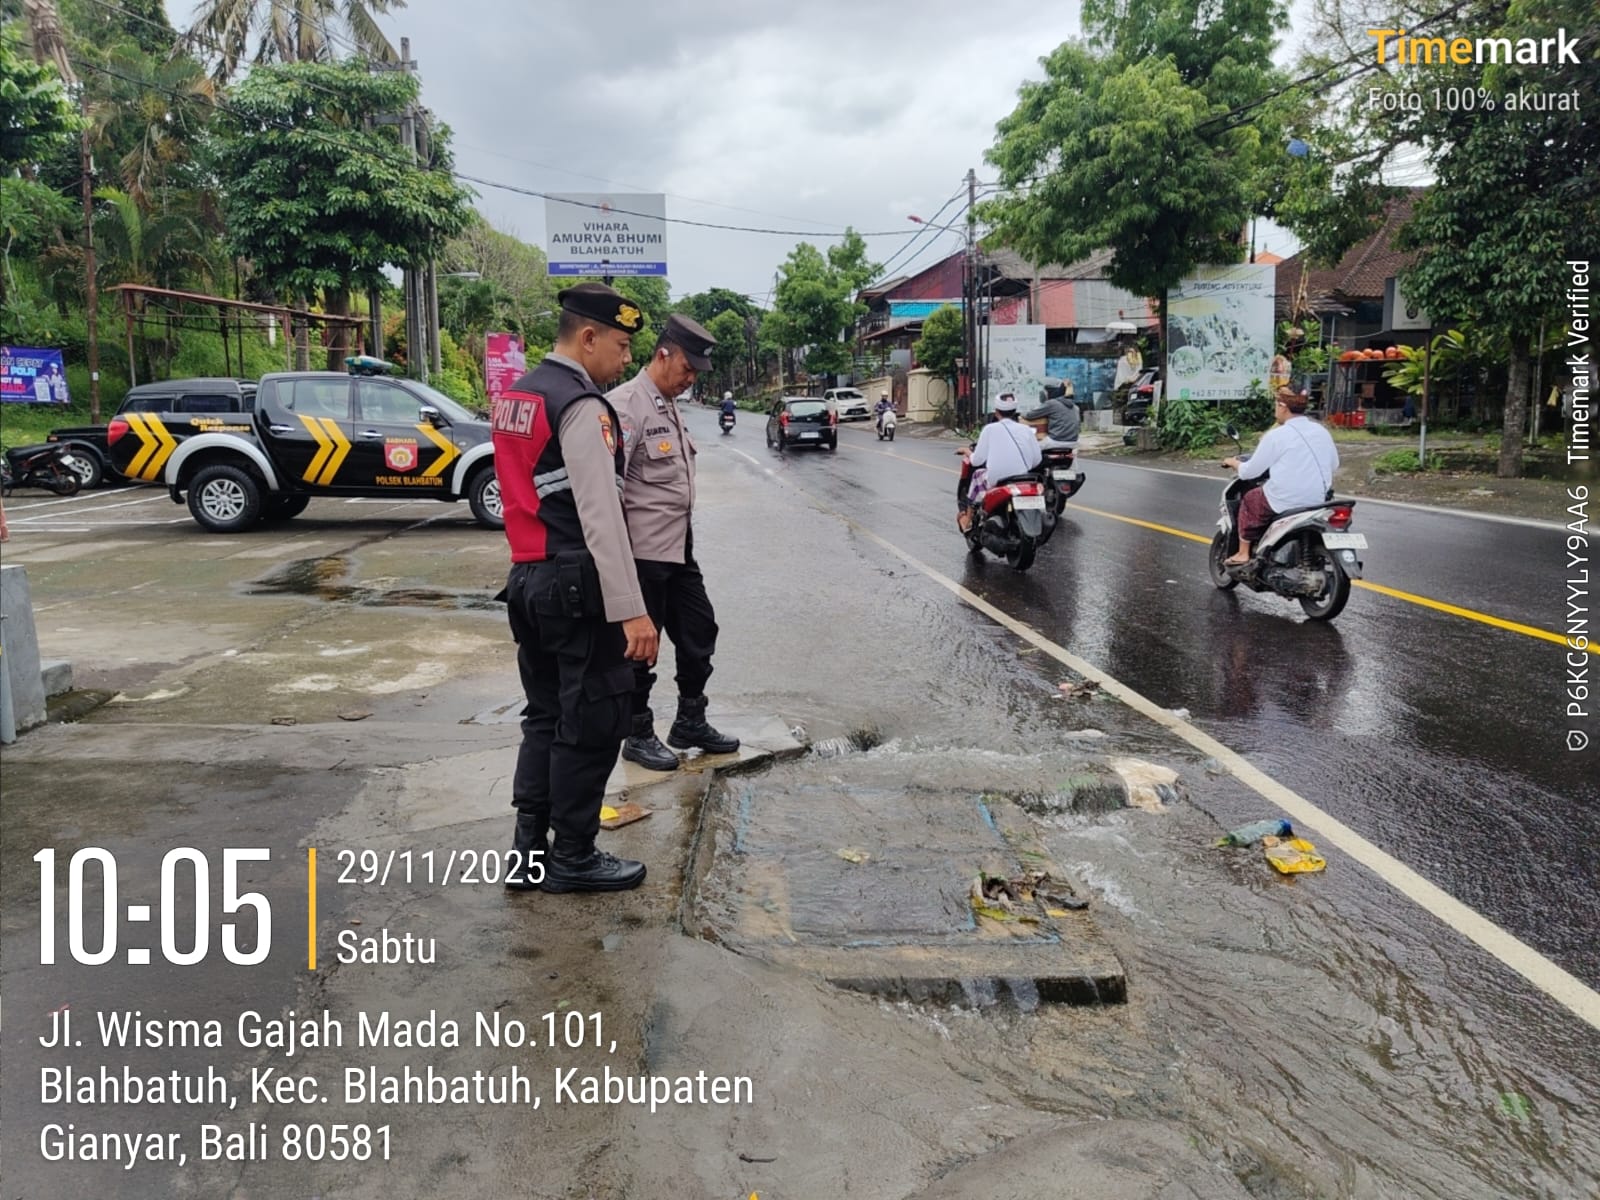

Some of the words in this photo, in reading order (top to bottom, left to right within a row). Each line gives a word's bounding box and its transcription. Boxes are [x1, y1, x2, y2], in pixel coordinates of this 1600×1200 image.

[583, 222, 629, 232] VIHARA
[552, 233, 612, 244] AMURVA
[616, 233, 662, 243] BHUMI
[570, 245, 644, 255] BLAHBATUH
[11, 366, 37, 376] POLRI
[190, 417, 224, 426] Quick
[491, 399, 537, 436] POLISI
[375, 475, 401, 486] POLSEK
